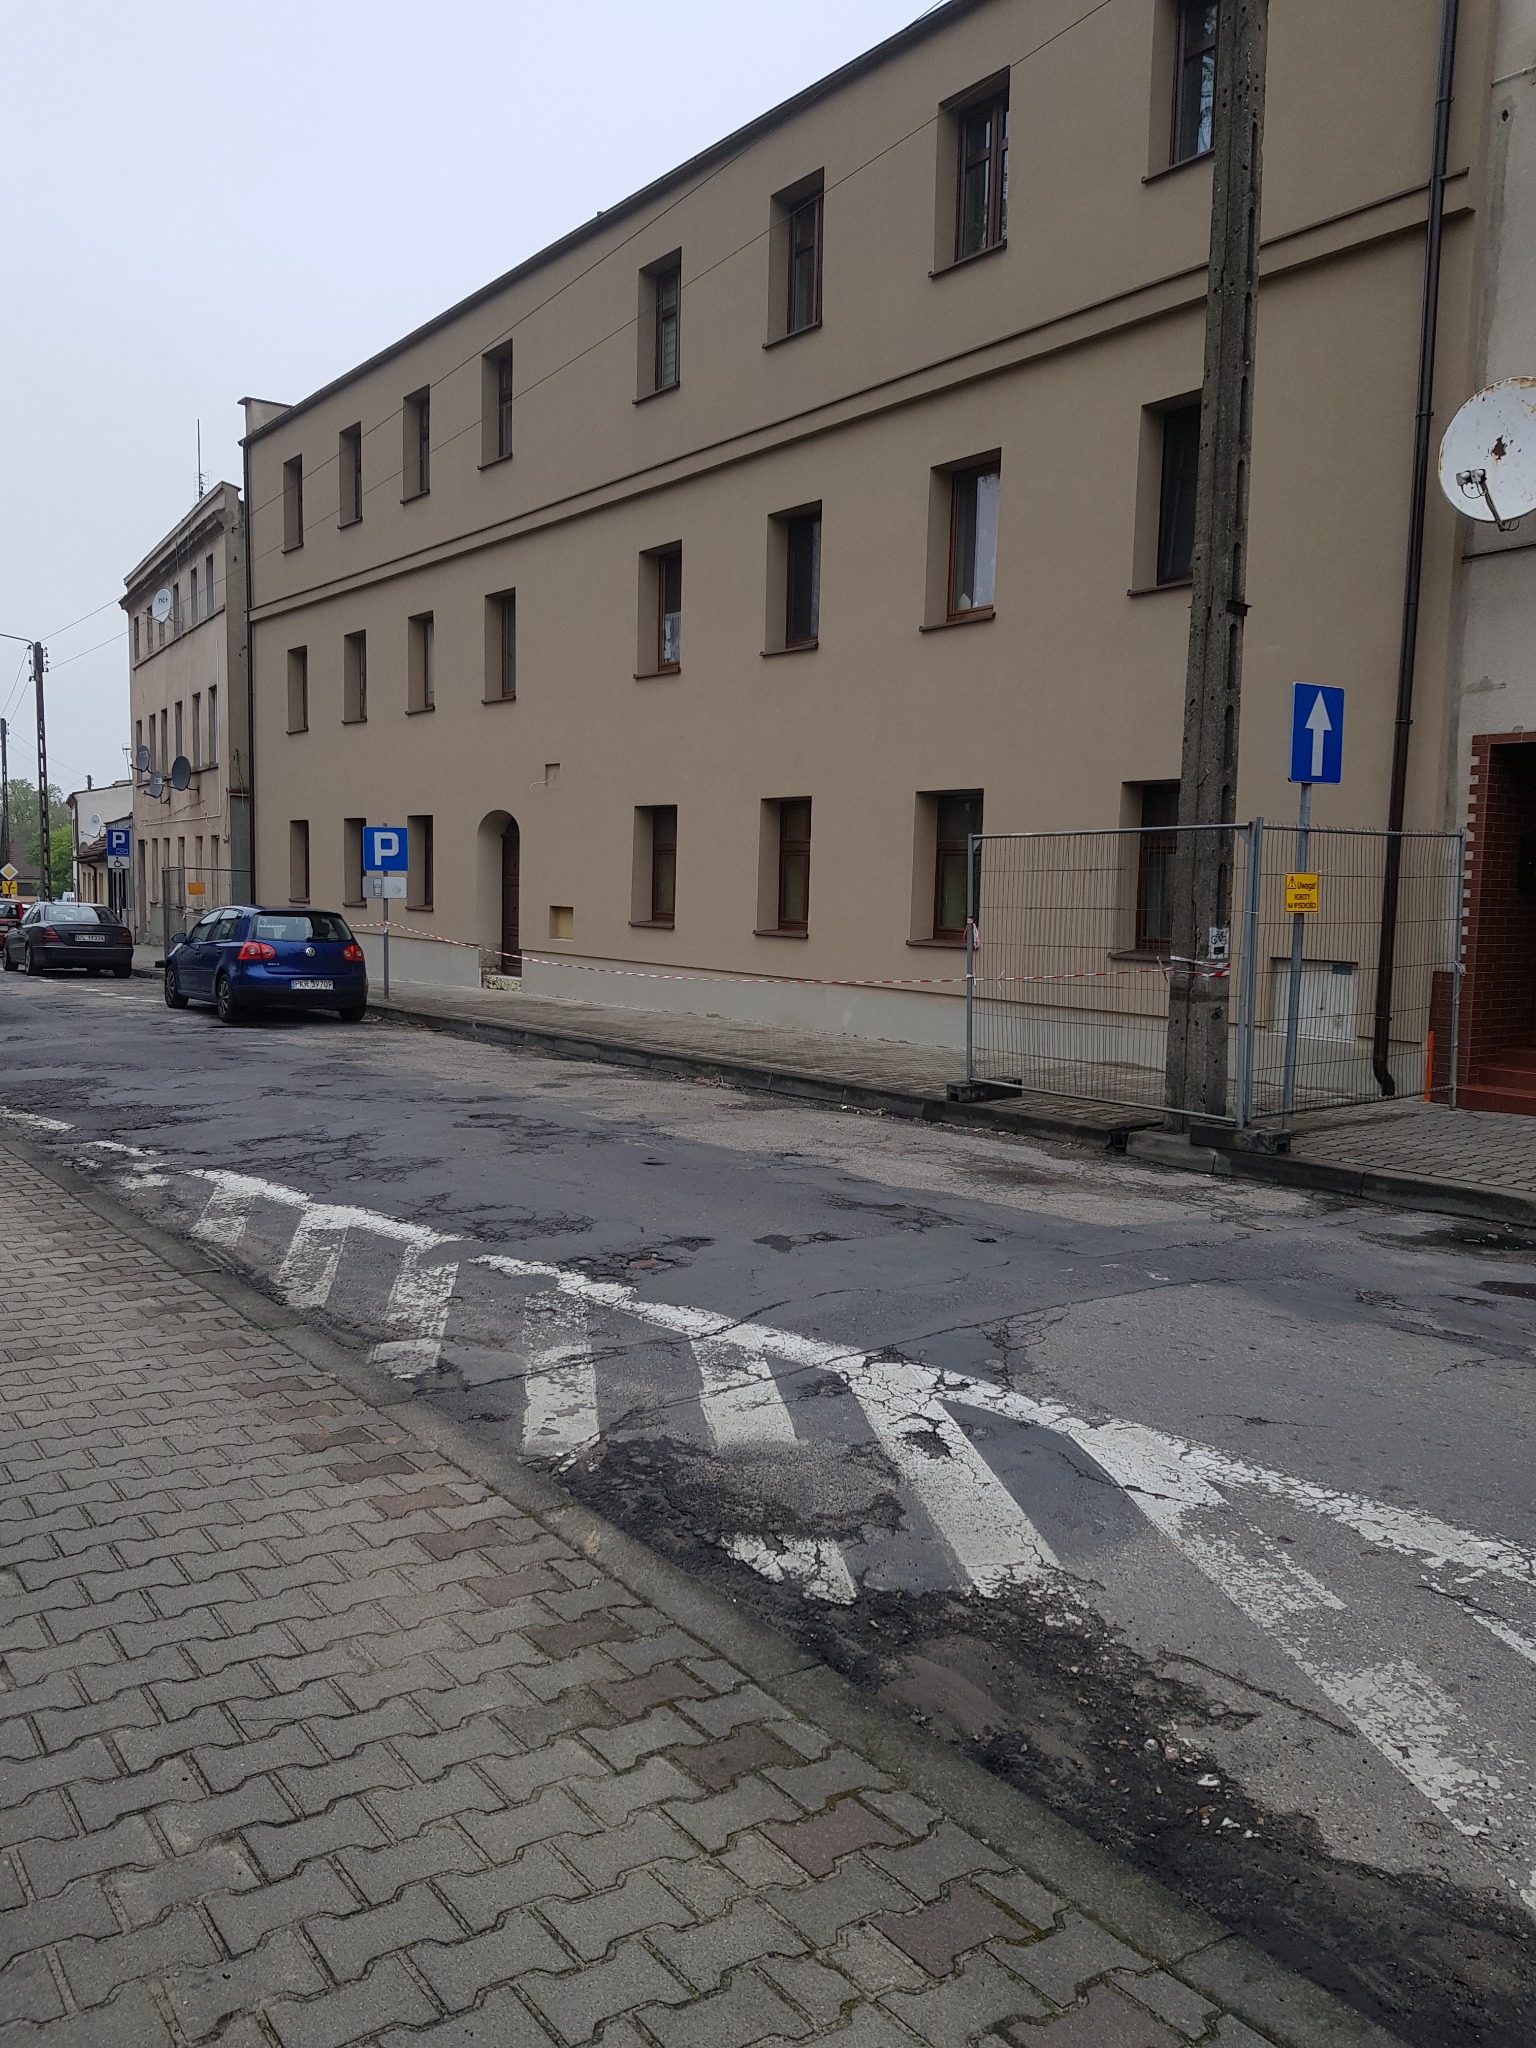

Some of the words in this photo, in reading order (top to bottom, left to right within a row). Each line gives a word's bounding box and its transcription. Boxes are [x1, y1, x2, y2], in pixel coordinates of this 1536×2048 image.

[112, 831, 126, 849] P
[373, 832, 400, 866] P
[1297, 881, 1317, 891] Uwaga!
[295, 980, 309, 988] PKR
[311, 980, 333, 988] 39709
